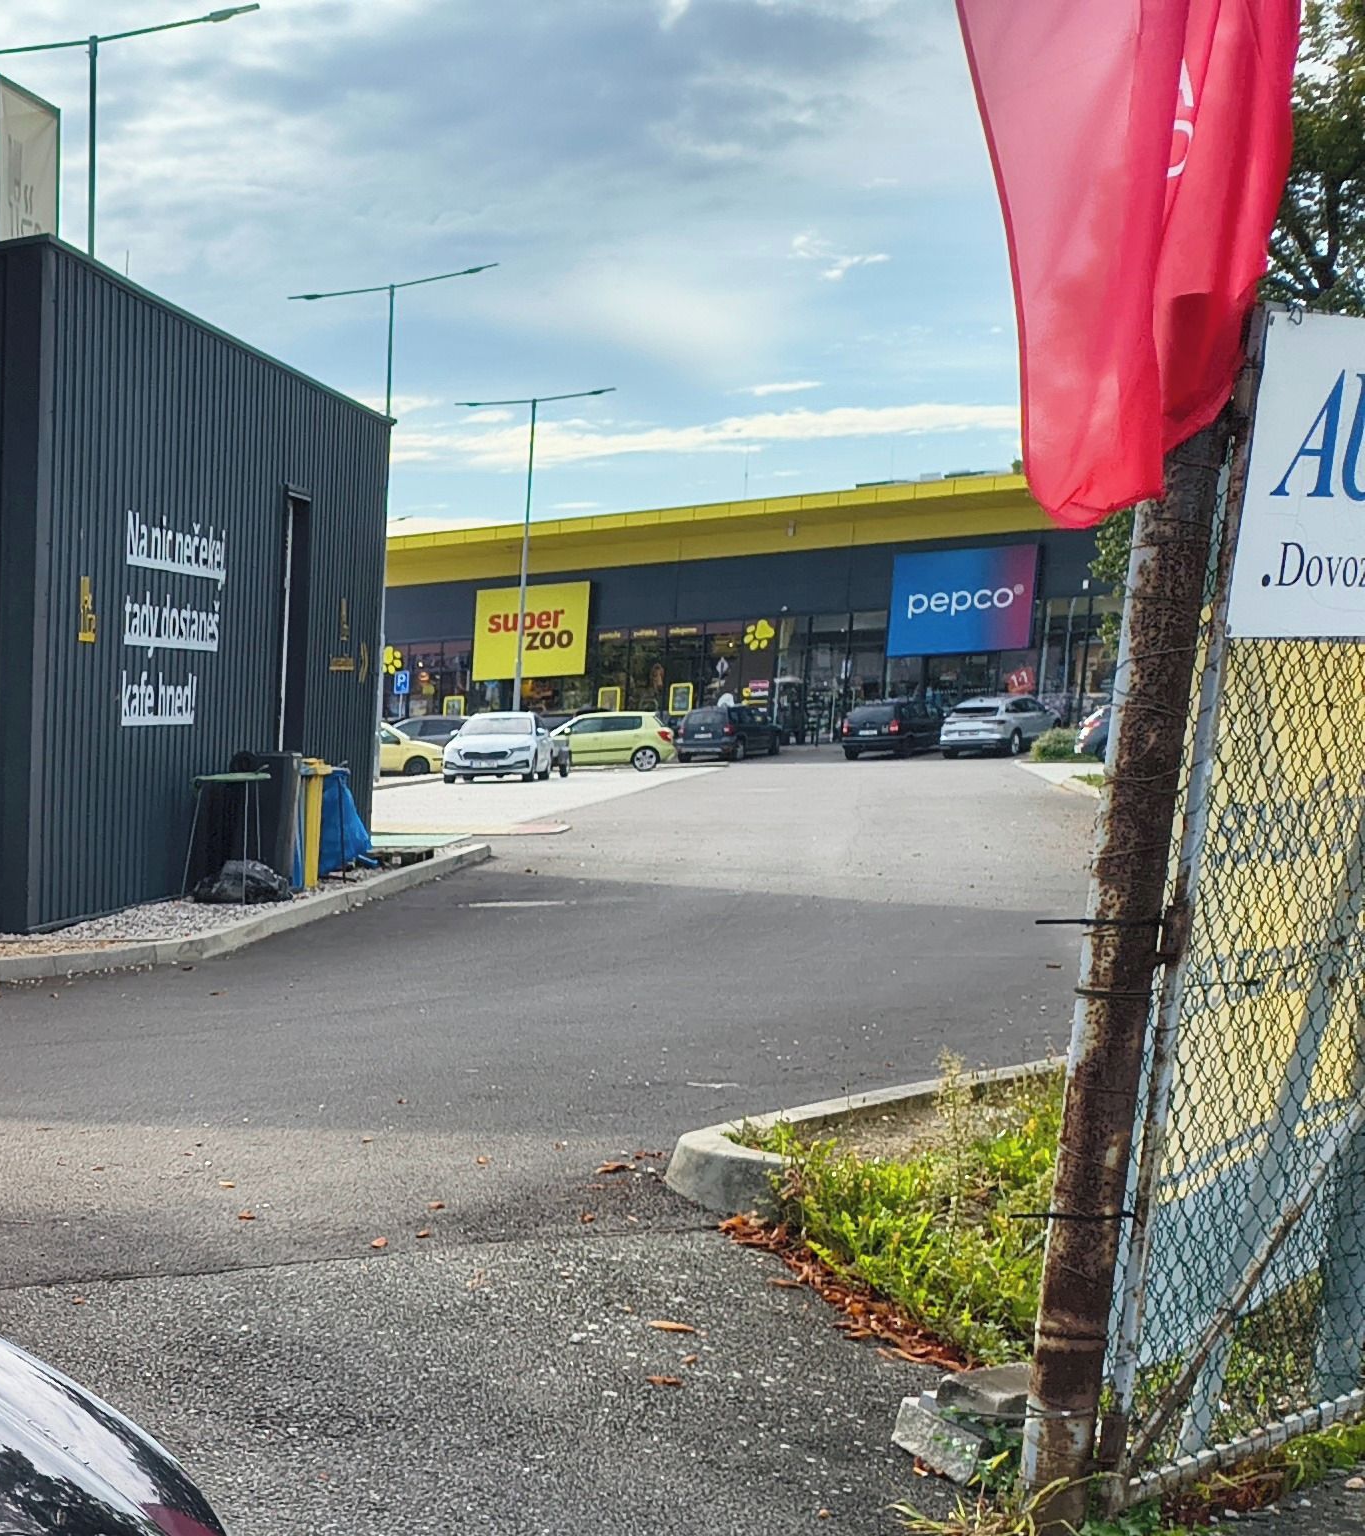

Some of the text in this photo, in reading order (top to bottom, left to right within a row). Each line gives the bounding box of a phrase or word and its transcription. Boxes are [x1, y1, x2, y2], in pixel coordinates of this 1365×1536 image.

[127, 510, 147, 567] Na
[151, 515, 173, 572] nic
[124, 591, 220, 658] tady dostaneš
[488, 608, 565, 634] super
[122, 670, 197, 725] kafe hned!
[397, 673, 407, 687] P
